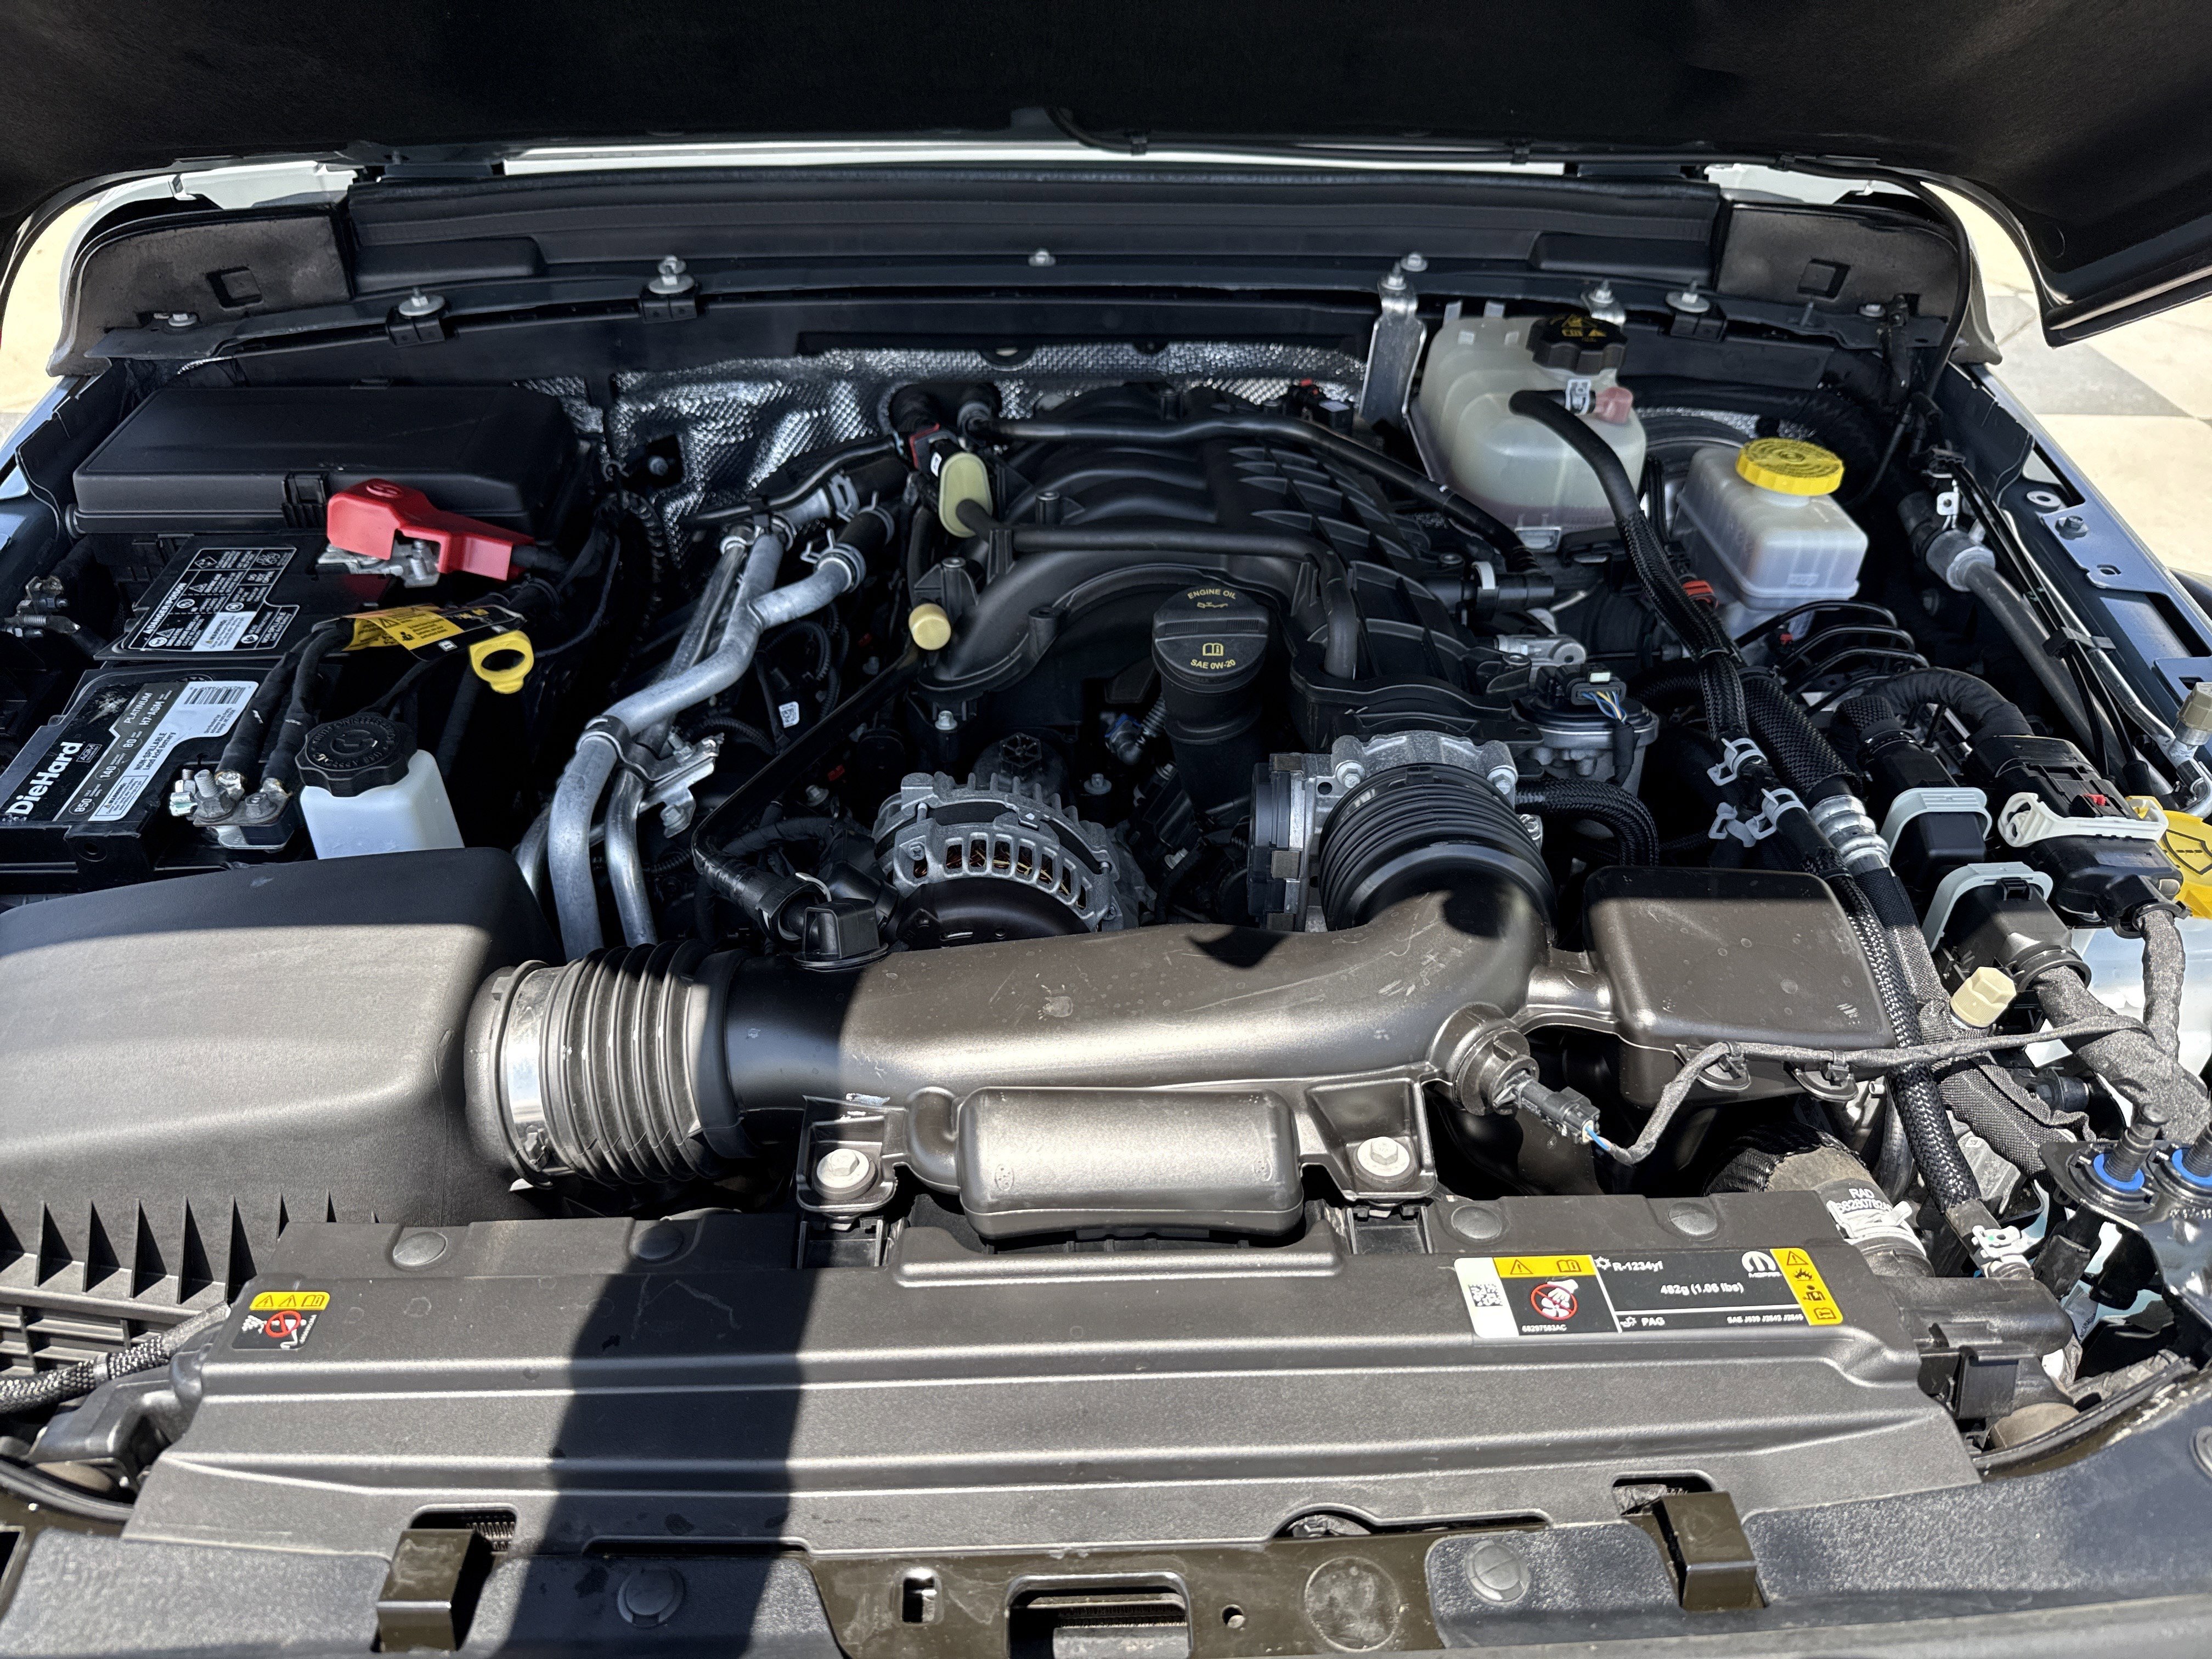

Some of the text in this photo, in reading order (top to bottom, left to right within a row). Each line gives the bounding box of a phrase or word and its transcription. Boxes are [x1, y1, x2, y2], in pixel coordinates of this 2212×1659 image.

[1187, 589, 1237, 600] ENGINE OIL
[1190, 658, 1236, 669] SAE 0W-20
[123, 692, 153, 724] PLATINUM
[123, 738, 137, 748] 80
[133, 732, 167, 770] NON-SPILLABLE
[100, 765, 117, 778] 140
[5, 742, 83, 815] DieHard
[74, 798, 93, 812] 850
[1848, 1188, 1875, 1199] RAD
[1612, 1261, 1663, 1272] R-1234yf
[1660, 1284, 1690, 1295] 482g
[1720, 1282, 1744, 1294] lbs)
[1641, 1317, 1665, 1326] PAG
